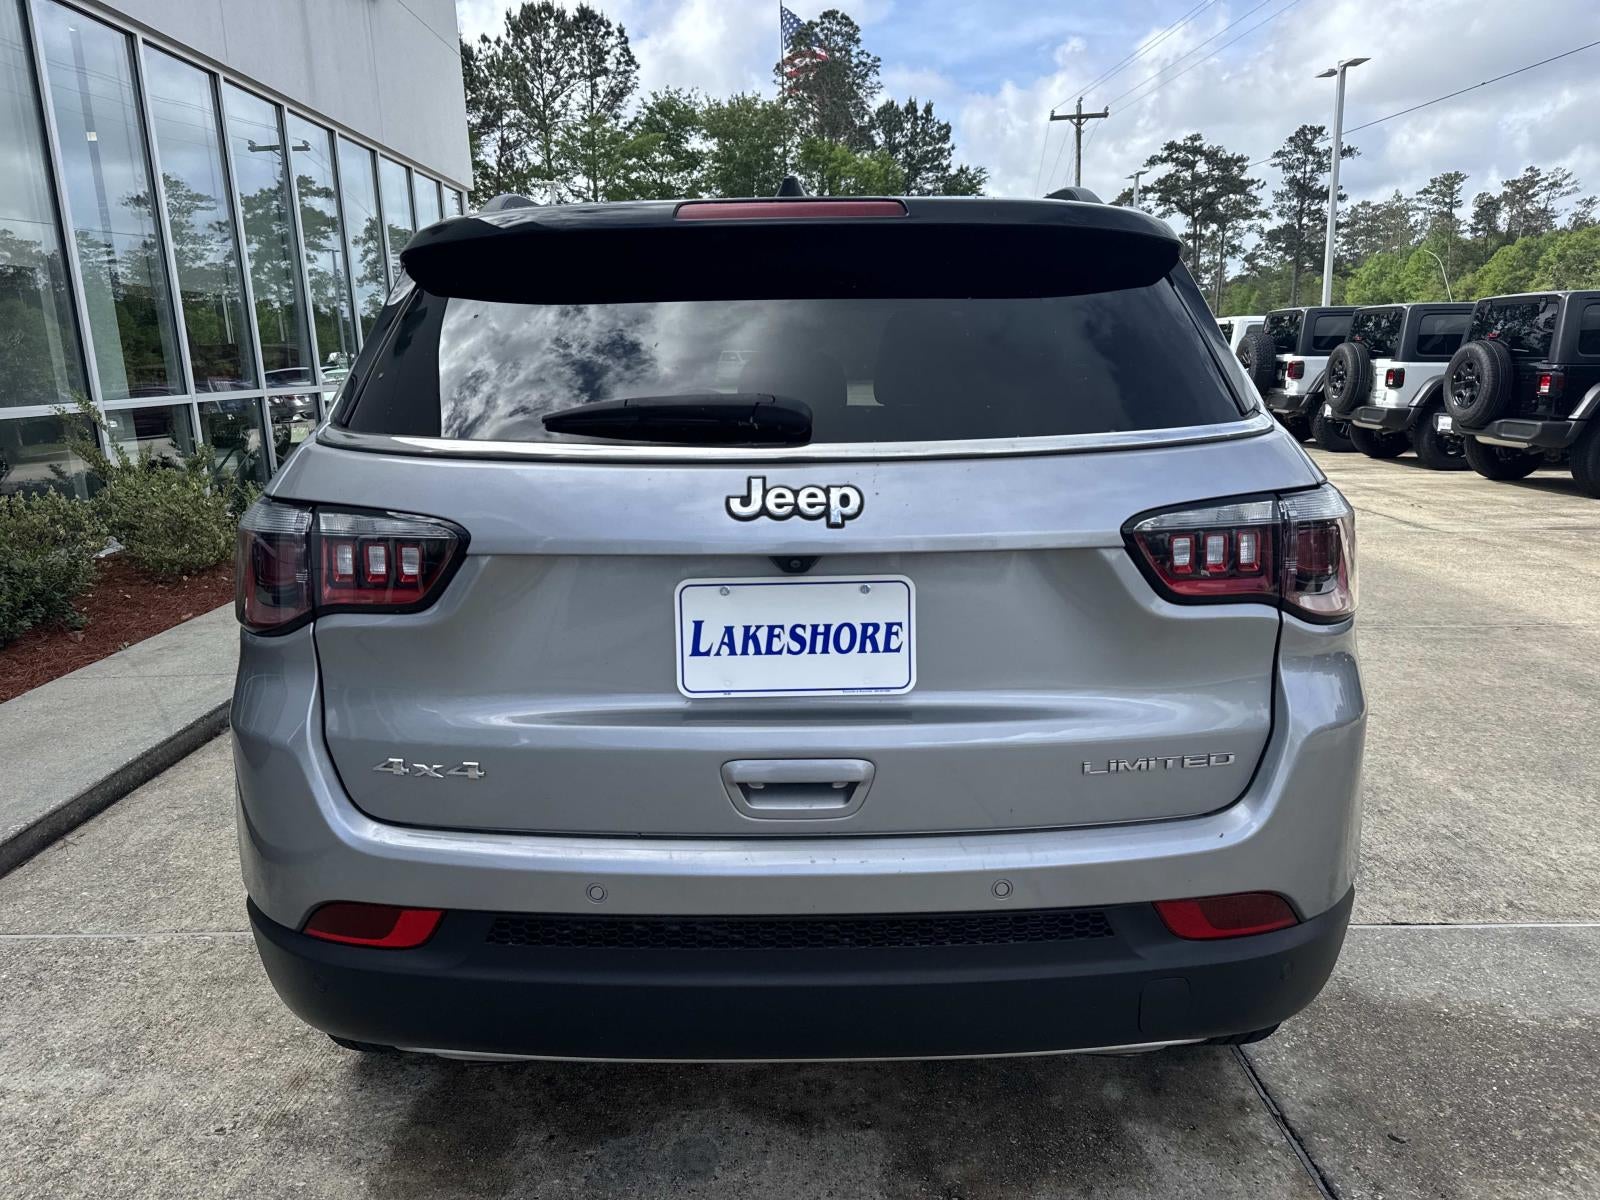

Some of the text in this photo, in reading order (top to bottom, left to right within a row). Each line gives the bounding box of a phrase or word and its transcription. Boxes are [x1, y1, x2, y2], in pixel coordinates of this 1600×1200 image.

[726, 476, 864, 528] Jeep
[689, 619, 904, 657] LAKESHORE
[1083, 752, 1236, 775] LIMITED
